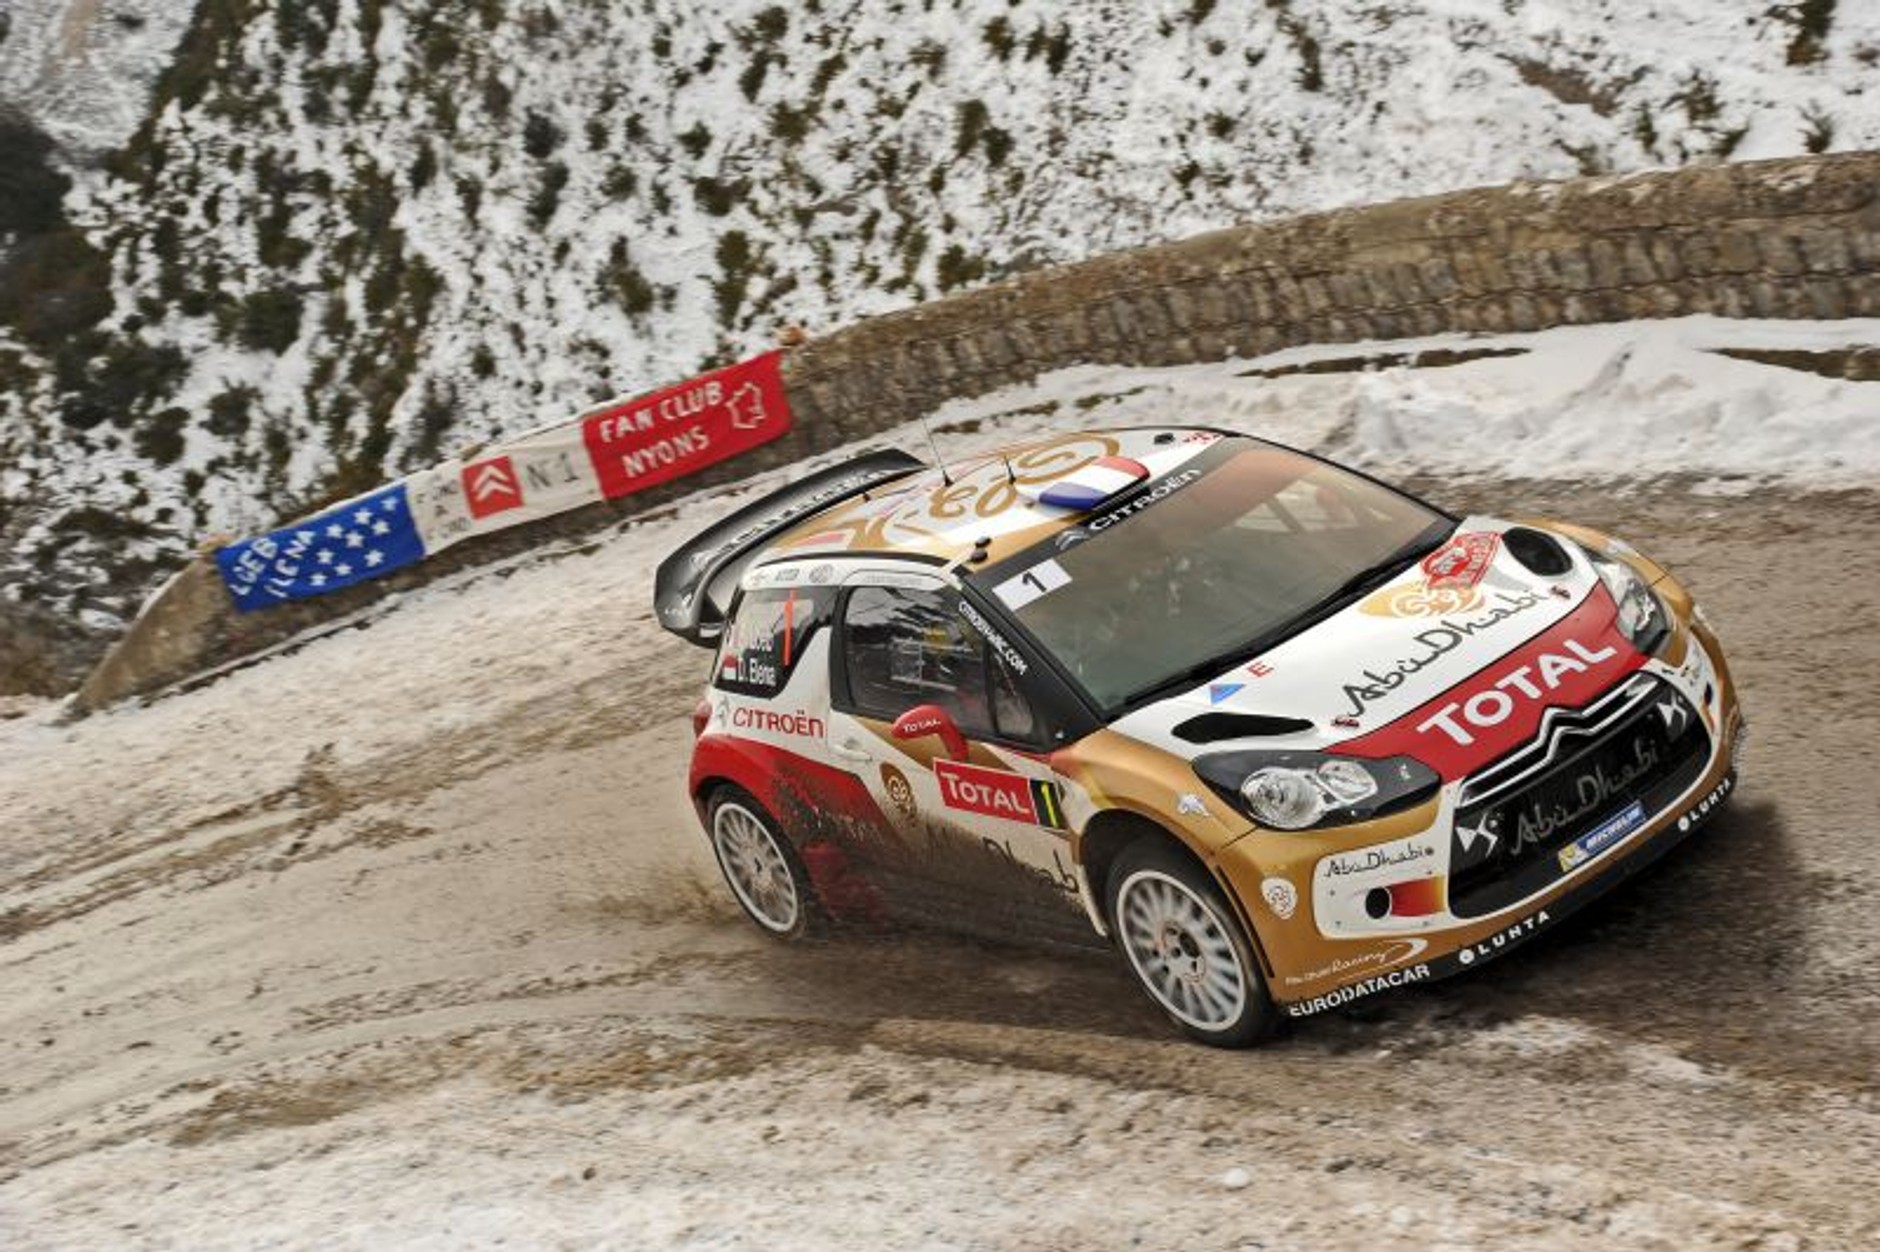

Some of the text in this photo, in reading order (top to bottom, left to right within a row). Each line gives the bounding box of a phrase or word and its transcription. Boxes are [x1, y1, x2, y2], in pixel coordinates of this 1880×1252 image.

[599, 380, 724, 443] FAN CLUB
[620, 425, 711, 479] NYONS
[1020, 571, 1048, 593] 1
[1415, 638, 1618, 747] TOTAL
[939, 771, 1031, 815] TOTAL
[1289, 963, 1431, 1017] EURODATACAR
